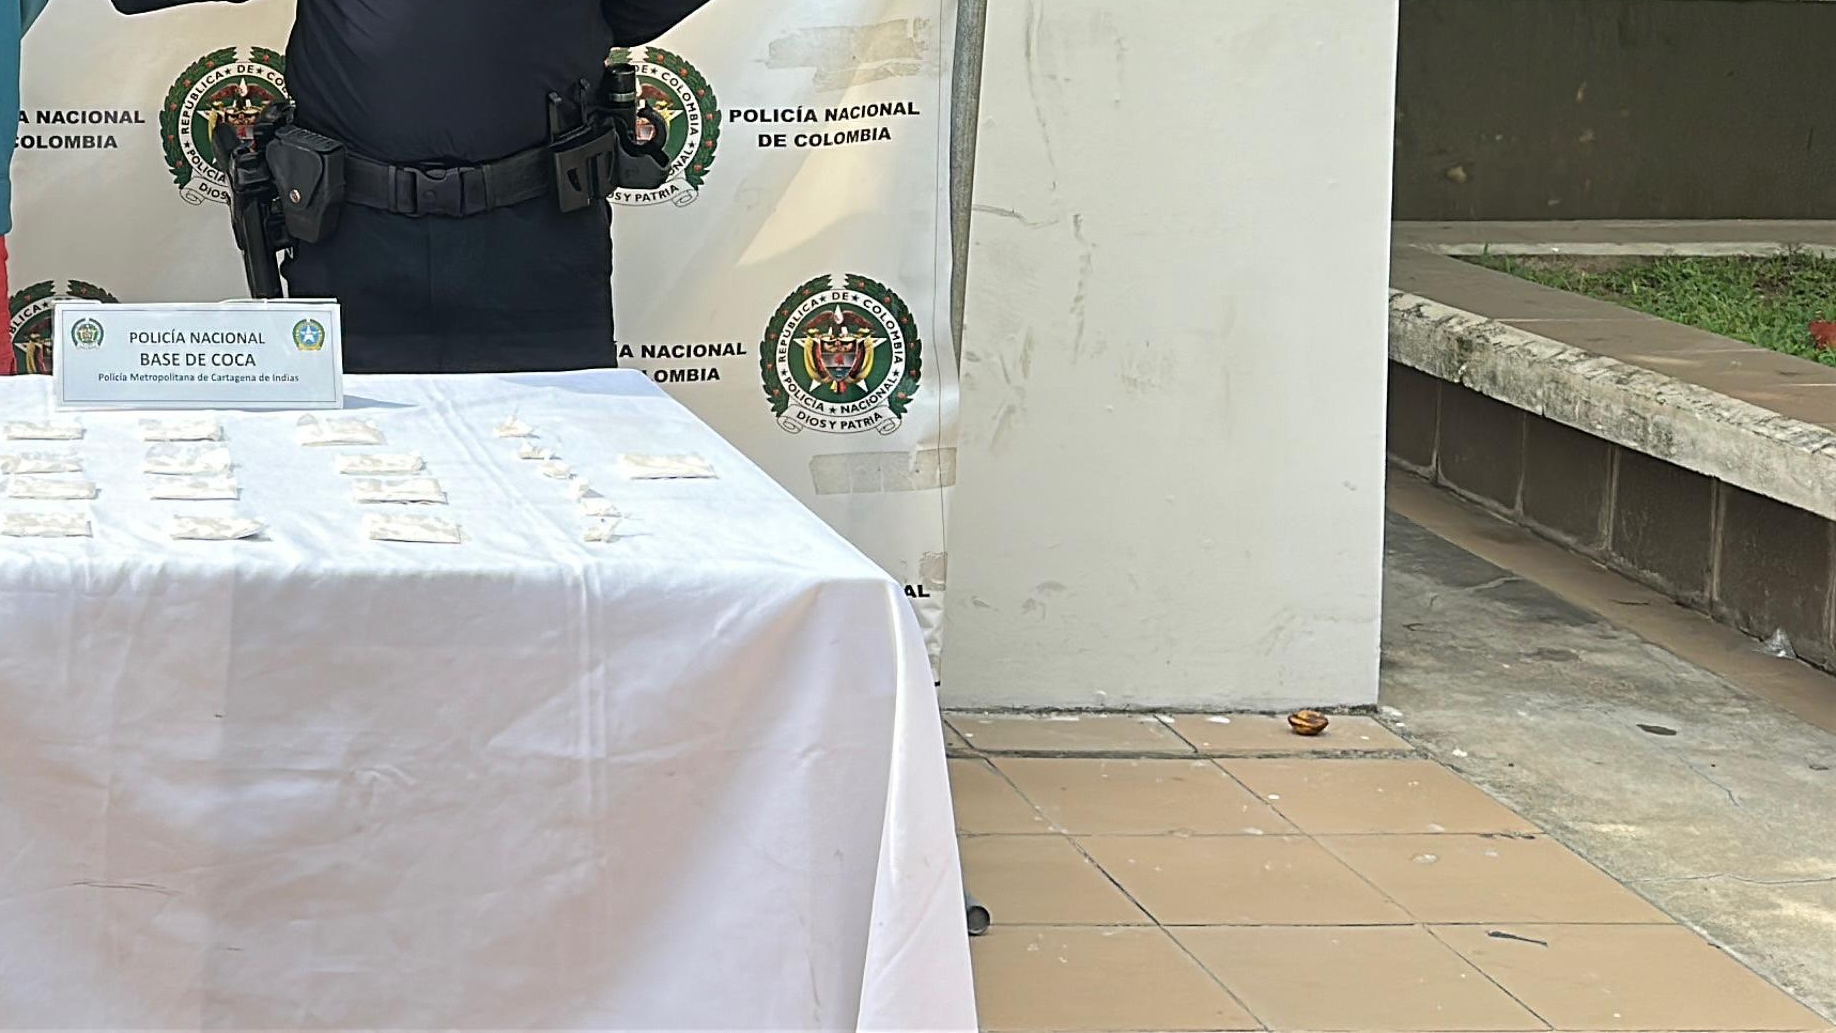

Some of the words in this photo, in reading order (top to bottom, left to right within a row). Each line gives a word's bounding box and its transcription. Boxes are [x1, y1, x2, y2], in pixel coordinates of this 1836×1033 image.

[36, 110, 146, 125] NACIONAL
[729, 105, 818, 123] POLICÍA
[824, 101, 921, 123] NACIONAL
[11, 134, 118, 150] OLOMBIA
[758, 133, 787, 148] DE
[793, 126, 892, 148] COLOMBIA
[833, 291, 852, 302] DE
[863, 299, 905, 363] COLOMBIA
[129, 328, 186, 344] POLICÍA
[190, 331, 266, 345] NACIONAL
[641, 342, 747, 359] NACIONAL
[140, 352, 181, 367] BASE
[185, 353, 206, 367] DE
[211, 353, 257, 367] COCA
[98, 372, 128, 382] Policía
[129, 372, 195, 383] Metropolitana
[197, 373, 209, 382] de
[211, 373, 257, 384] Cartagena
[258, 373, 270, 382] de
[272, 373, 299, 382] Indias
[650, 367, 721, 384] OMBIA
[840, 377, 899, 415] NACIONAL
[797, 410, 829, 429] DIOS
[839, 411, 885, 432] PATRIA
